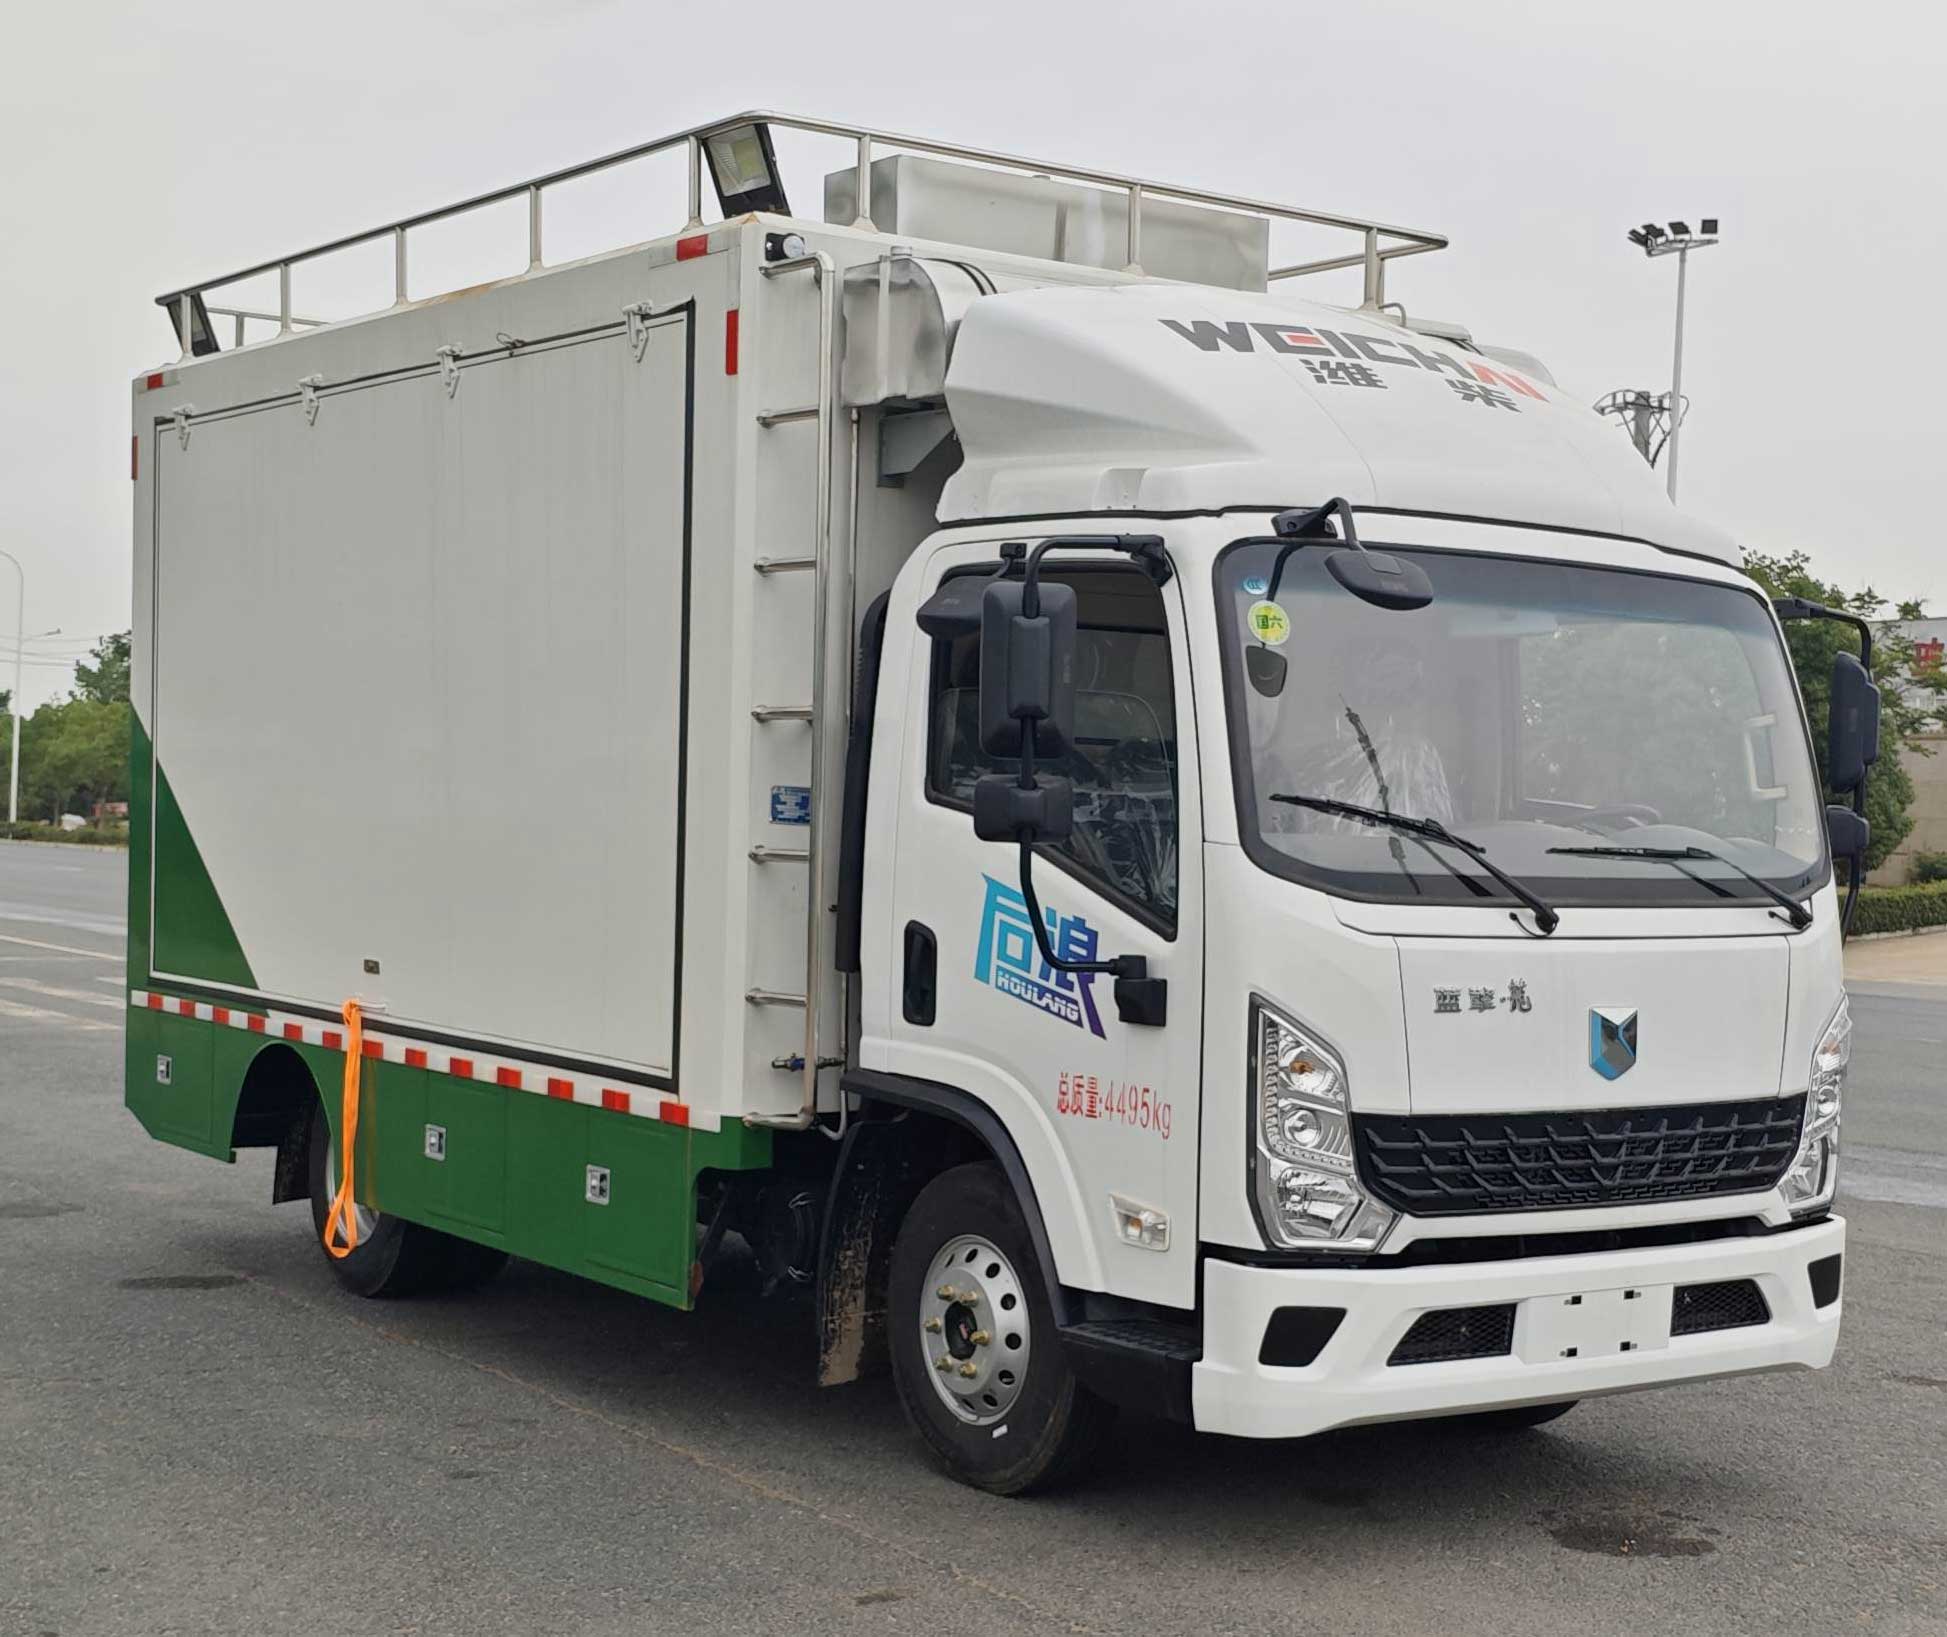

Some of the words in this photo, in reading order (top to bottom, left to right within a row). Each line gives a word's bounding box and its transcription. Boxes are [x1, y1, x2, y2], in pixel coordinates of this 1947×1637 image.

[1300, 358, 1523, 414] 潍柴
[1255, 613, 1284, 630] 国六
[997, 970, 1080, 1022] HOULANG
